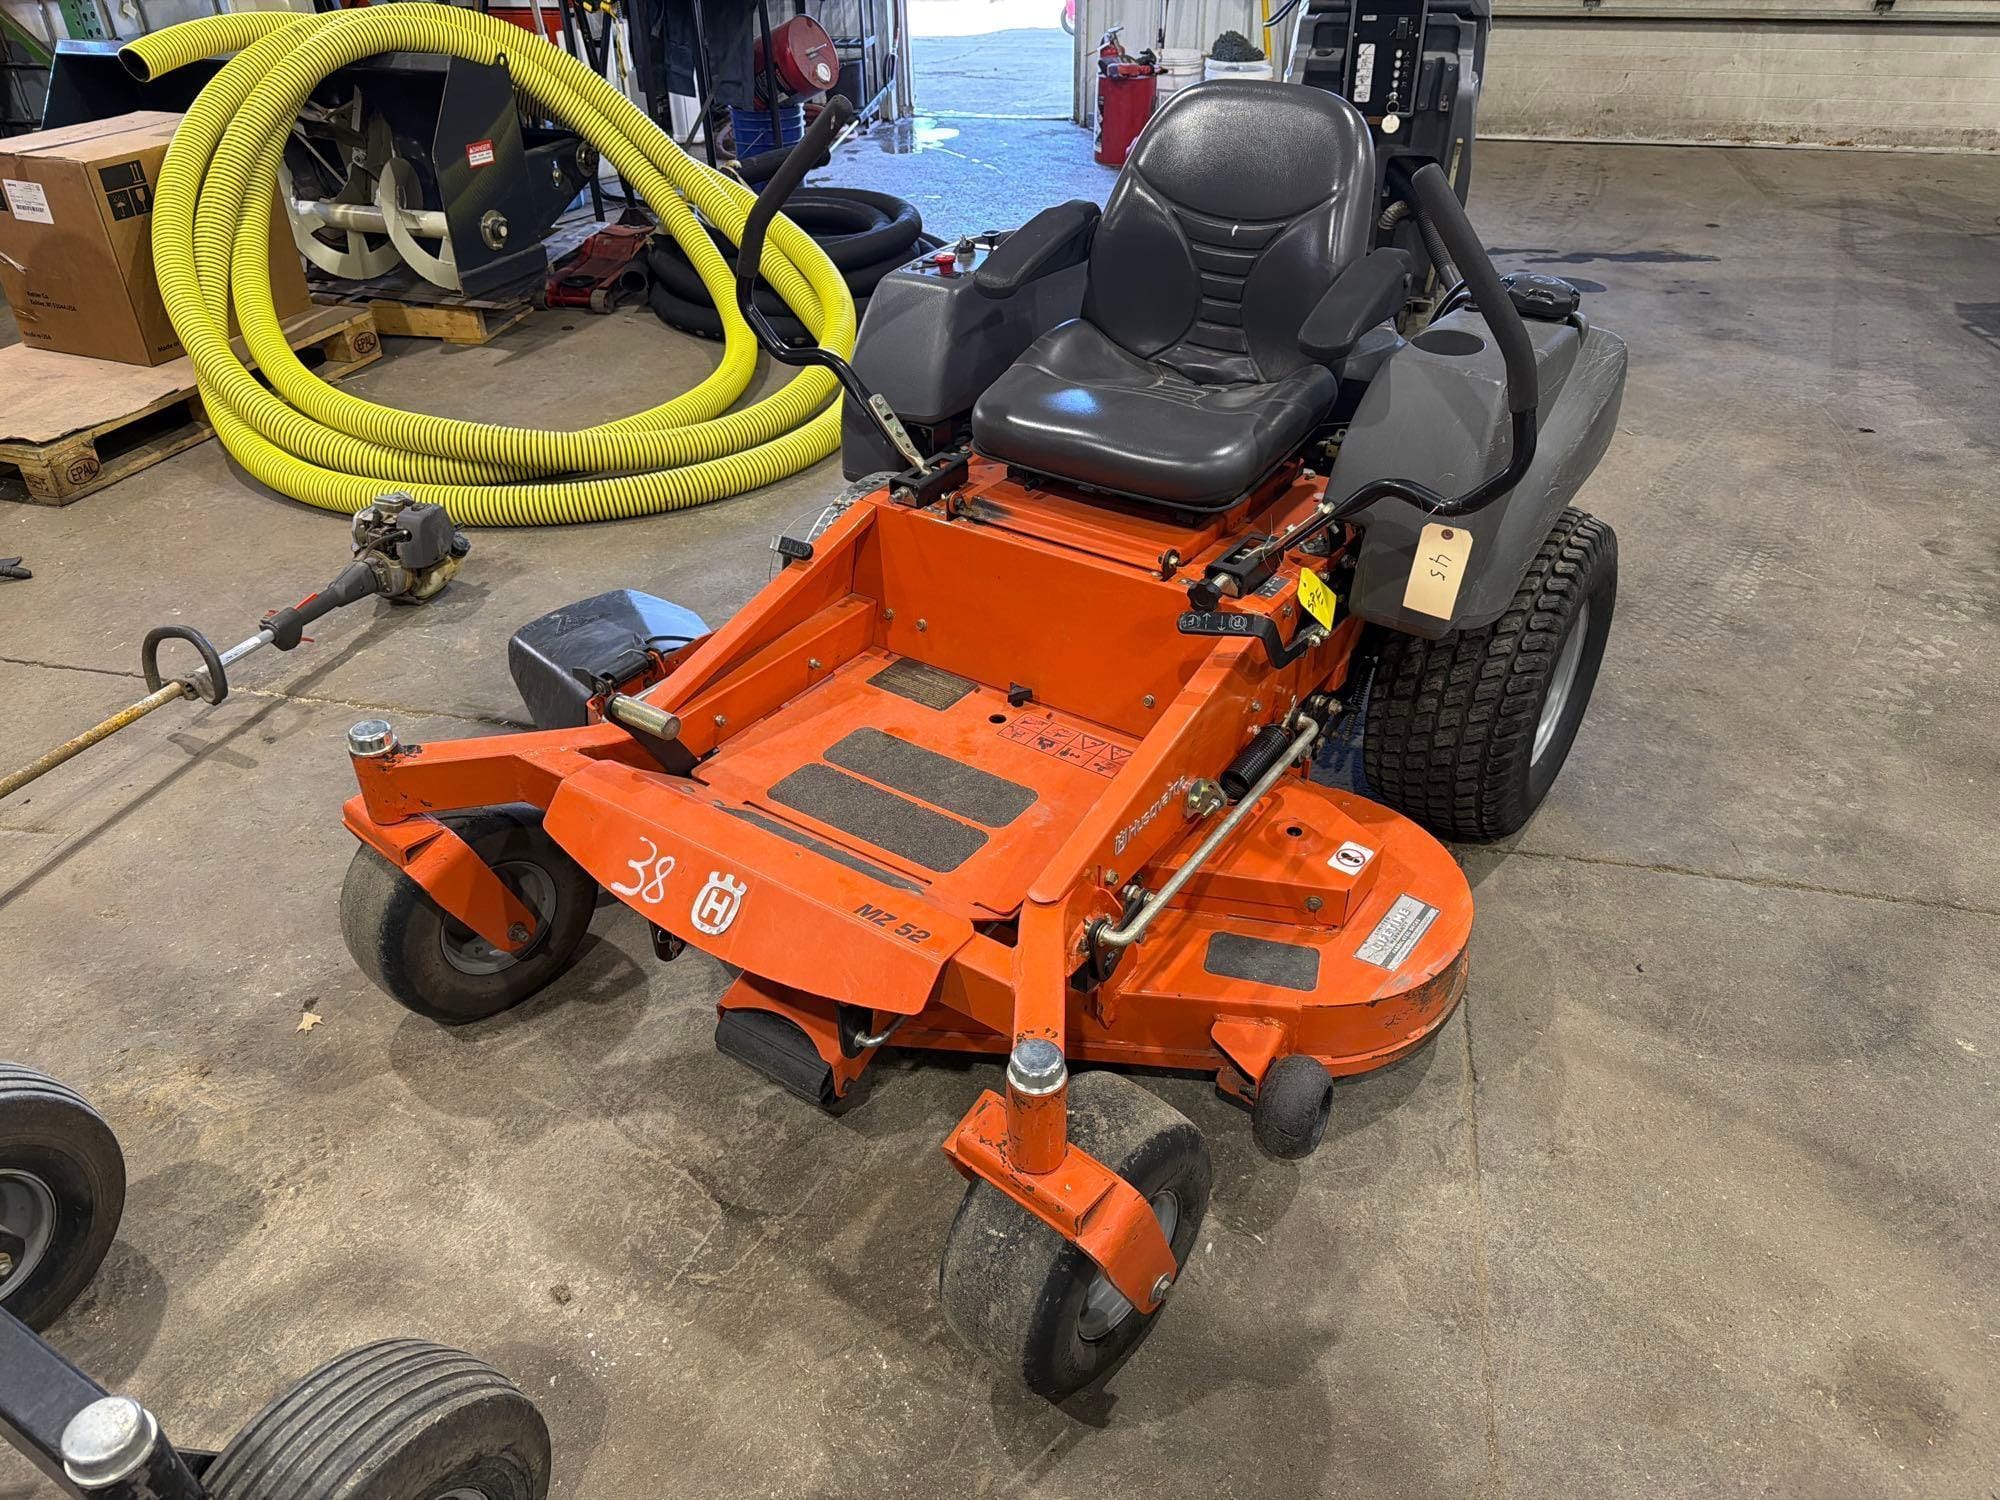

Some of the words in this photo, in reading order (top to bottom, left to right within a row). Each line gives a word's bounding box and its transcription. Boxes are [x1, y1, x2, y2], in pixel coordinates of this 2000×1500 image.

[70, 461, 97, 482] EPAL
[610, 836, 676, 904] 38
[852, 903, 891, 929] MZ
[894, 921, 933, 945] 52
[1370, 907, 1411, 952] LIFETIME
